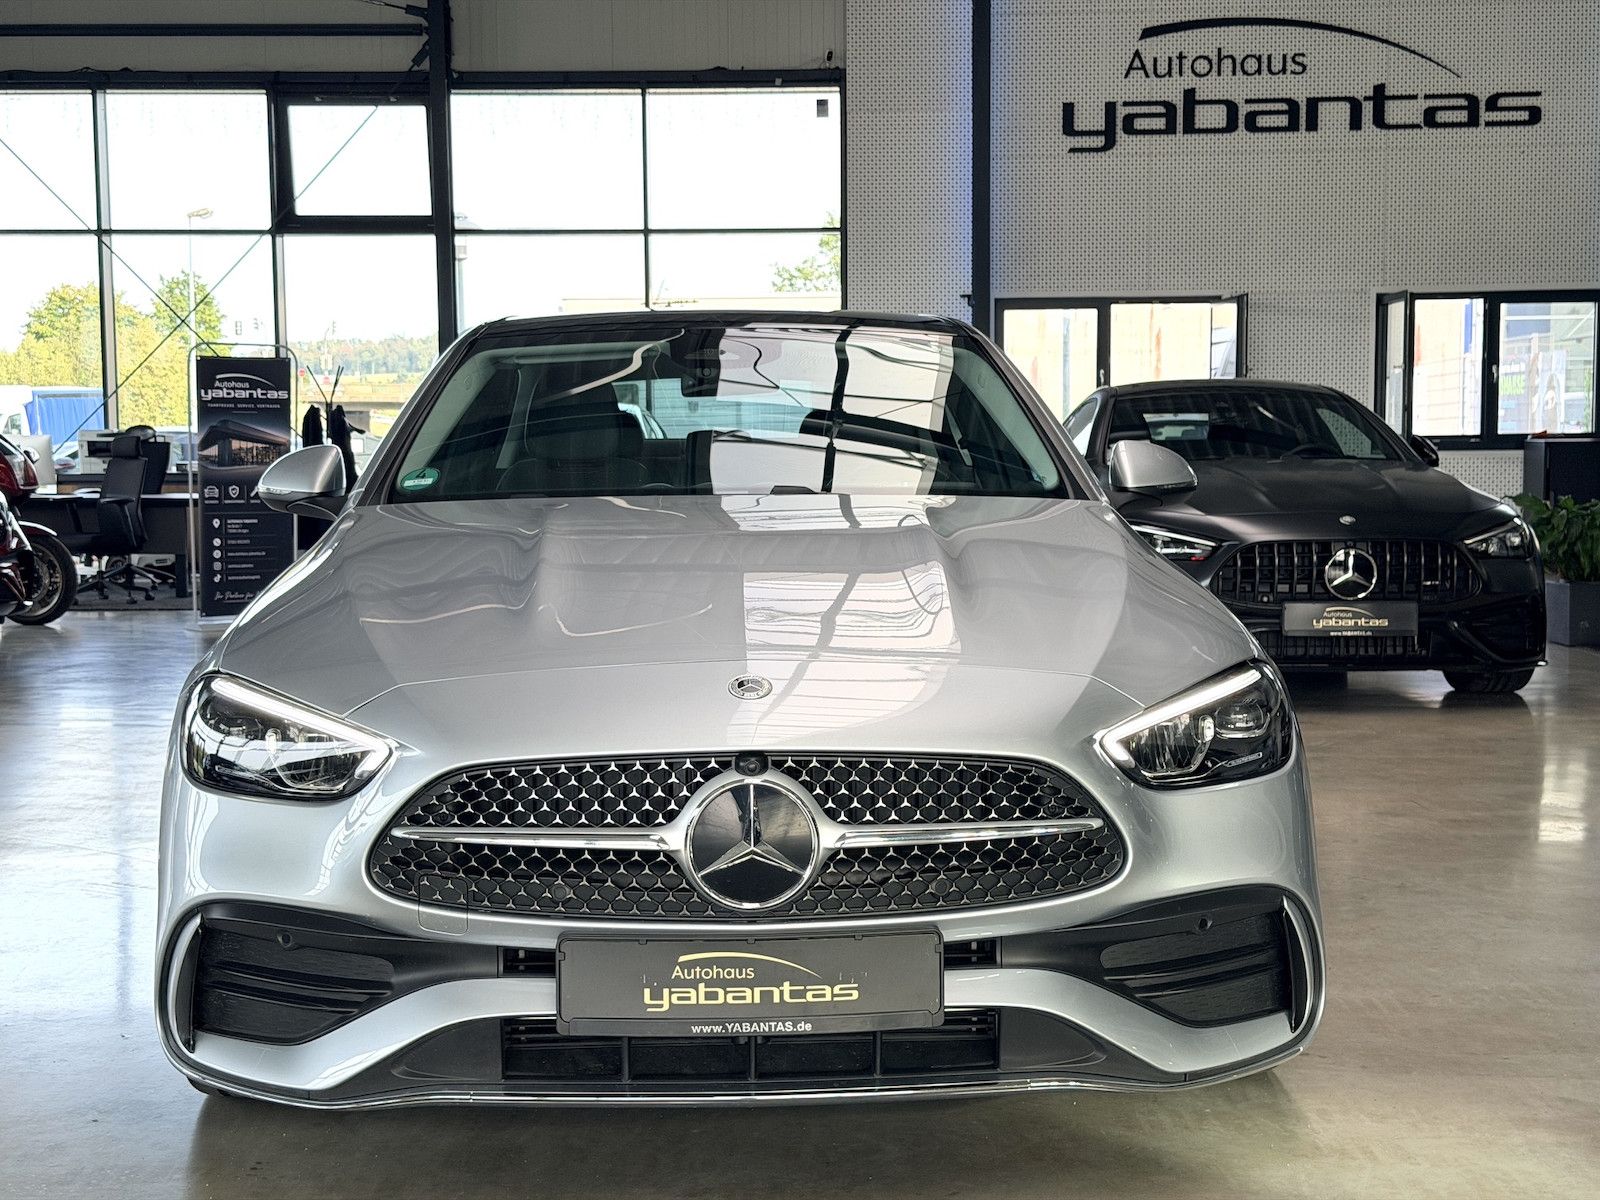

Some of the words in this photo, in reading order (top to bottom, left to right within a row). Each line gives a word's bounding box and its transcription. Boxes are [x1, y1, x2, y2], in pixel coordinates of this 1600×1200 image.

[1124, 47, 1308, 80] Autohaus
[1062, 83, 1542, 153] yabantas
[214, 380, 250, 389] Autohaus
[201, 387, 289, 401] yabantas
[1312, 617, 1389, 629] yabantas
[671, 964, 755, 980] Autohaus
[643, 981, 859, 1012] yabantas
[691, 1021, 813, 1034] www.YABANTAS.de
